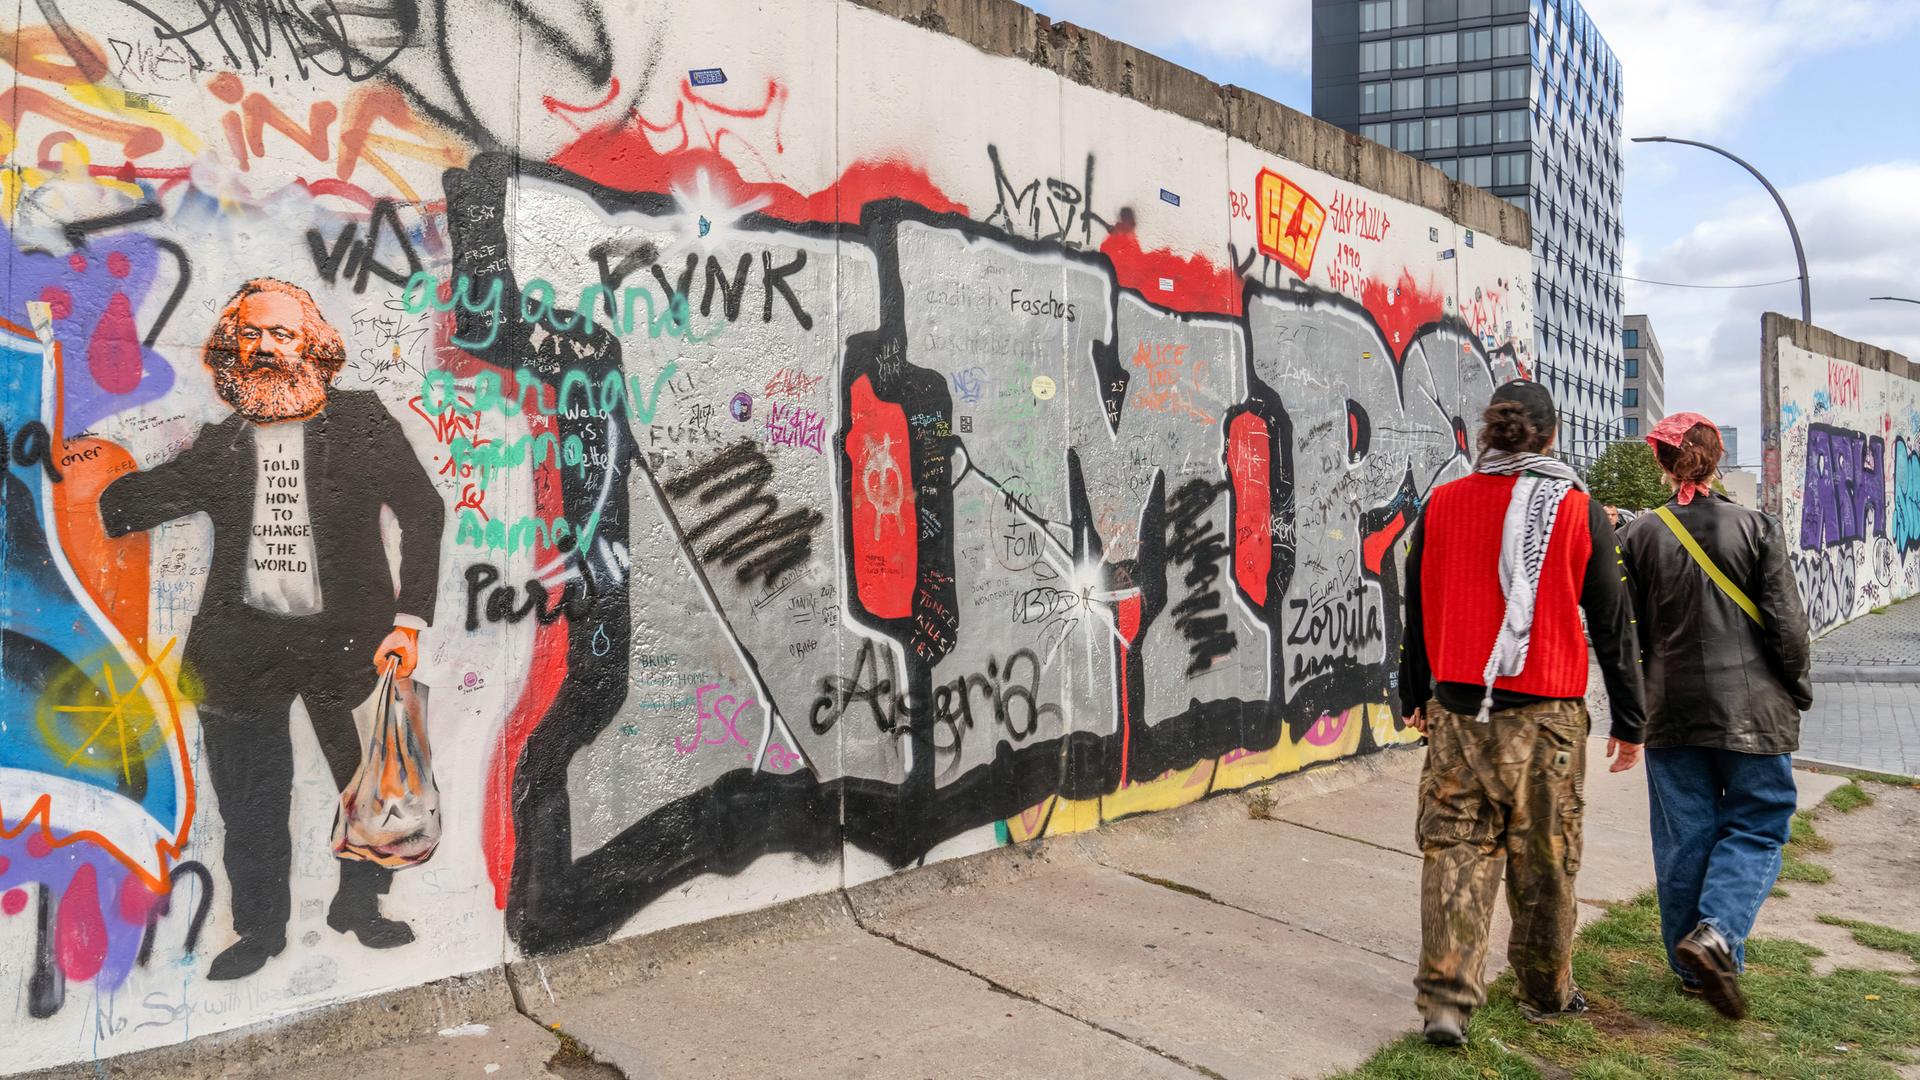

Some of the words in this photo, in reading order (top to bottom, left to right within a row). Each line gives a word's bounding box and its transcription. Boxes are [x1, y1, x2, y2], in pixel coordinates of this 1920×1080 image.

[1229, 190, 1251, 221] BR
[1010, 288, 1076, 323] Faschos
[1111, 380, 1125, 392] 25
[263, 459, 300, 472] TOLD
[266, 475, 298, 488] YOU
[265, 492, 299, 504] HOW
[271, 508, 293, 521] TO
[252, 524, 311, 537] CHANGE
[265, 543, 297, 555] THE
[1003, 531, 1039, 561] TOM
[189, 567, 207, 577] 25
[254, 558, 307, 573] WORLD
